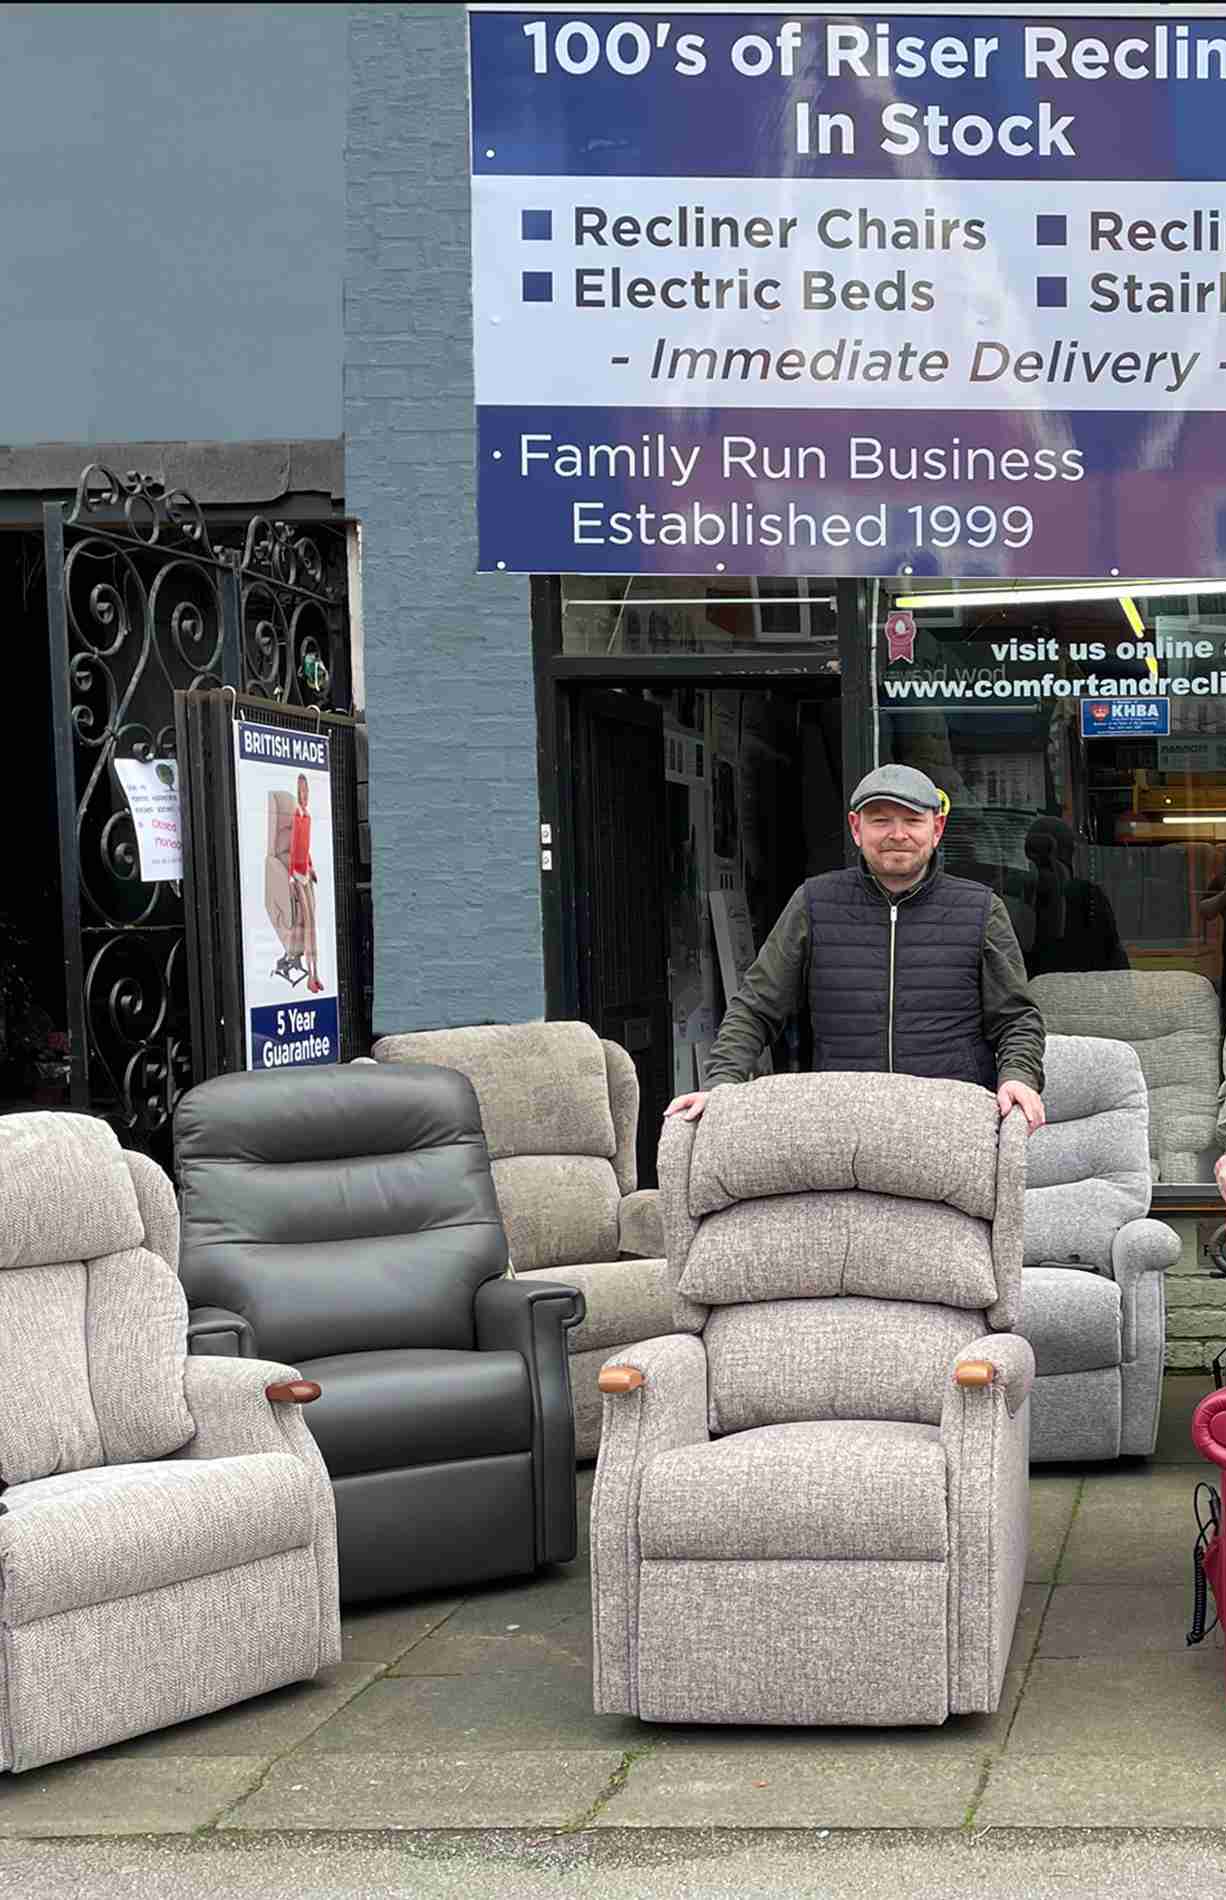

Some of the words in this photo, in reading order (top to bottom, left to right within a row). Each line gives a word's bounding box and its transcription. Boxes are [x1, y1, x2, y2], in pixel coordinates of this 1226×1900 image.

[523, 21, 706, 76] 100's
[731, 21, 802, 77] of
[826, 22, 999, 79] Riser
[796, 102, 855, 154] In
[880, 102, 1076, 157] Stock
[574, 205, 798, 249] Recliner
[817, 207, 987, 251] Chairs
[575, 266, 781, 311] Electric
[803, 269, 935, 312] Beds
[650, 338, 948, 382] Immediate
[969, 340, 1200, 392] Delivery
[520, 434, 700, 487] Family
[723, 436, 826, 479] Run
[850, 437, 1084, 481] Business
[573, 501, 887, 547] Established
[907, 505, 1034, 548] 1999
[991, 638, 1060, 662] visit
[1069, 642, 1106, 661] us
[1116, 637, 1214, 662] online
[1112, 704, 1159, 717] KHBA
[244, 731, 291, 758] BRITISH
[292, 739, 325, 764] MADE
[277, 1010, 285, 1035] 5
[288, 1008, 316, 1033] Year
[263, 1034, 330, 1067] Guarantee
